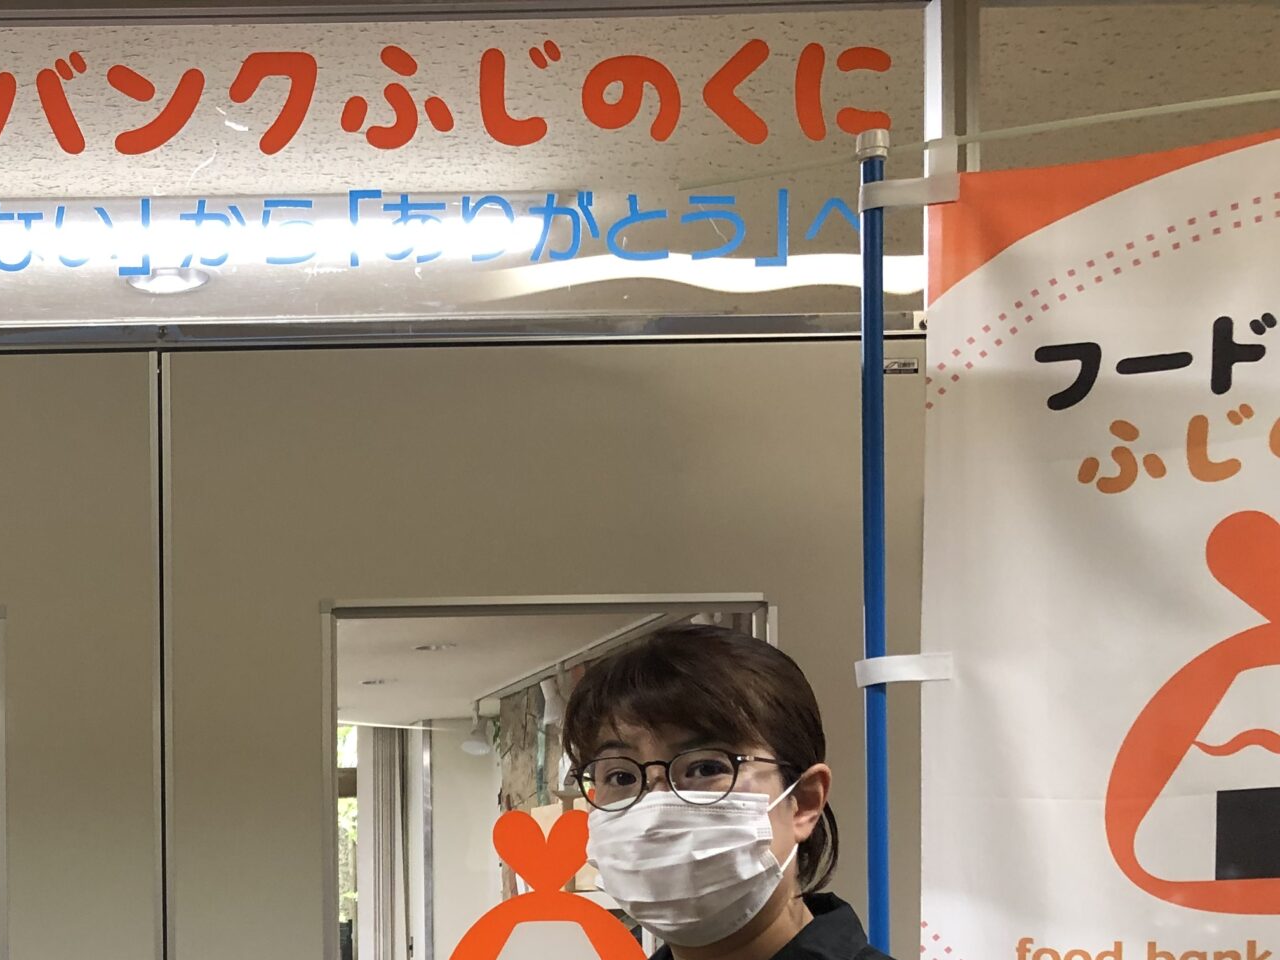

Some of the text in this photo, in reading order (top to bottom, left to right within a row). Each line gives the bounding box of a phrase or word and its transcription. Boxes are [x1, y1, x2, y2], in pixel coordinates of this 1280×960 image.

[1034, 312, 1277, 411] フード
[1077, 403, 1280, 494] ふじ
